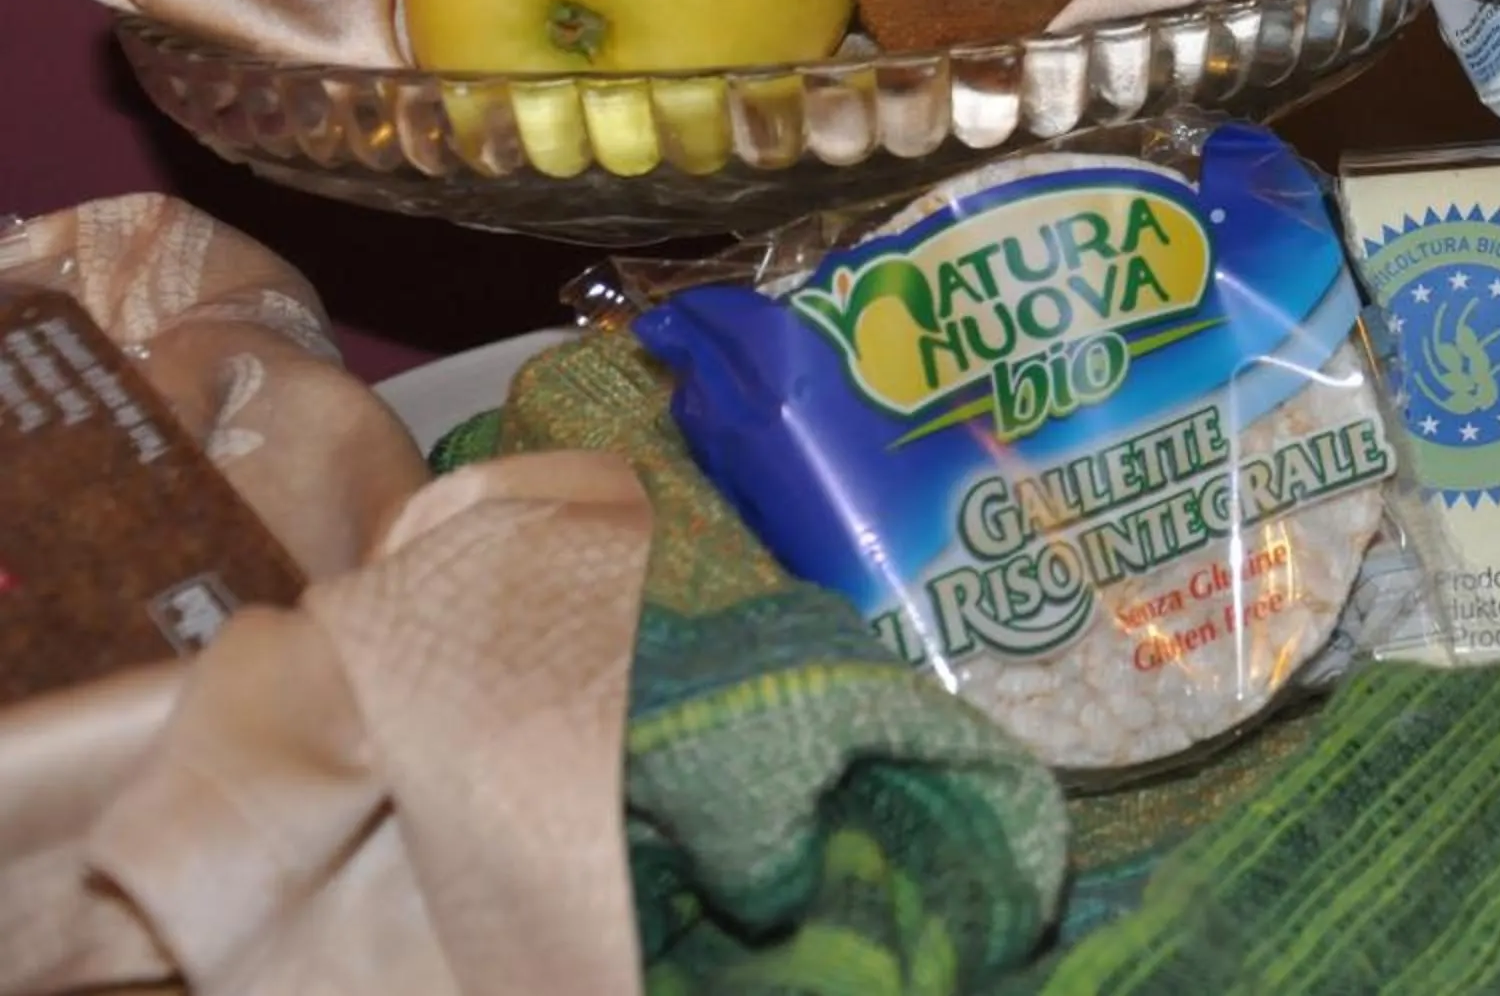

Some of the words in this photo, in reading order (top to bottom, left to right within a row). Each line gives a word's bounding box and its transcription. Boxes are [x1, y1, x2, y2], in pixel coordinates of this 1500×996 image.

[794, 197, 1171, 344] NATURA
[917, 254, 1171, 390] NUOVA
[992, 332, 1130, 442] bio
[928, 529, 1098, 659] RISO
[1098, 419, 1389, 588] INTEGRALE
[957, 405, 1231, 562] GALLETTE
[1189, 543, 1288, 601] Gluine
